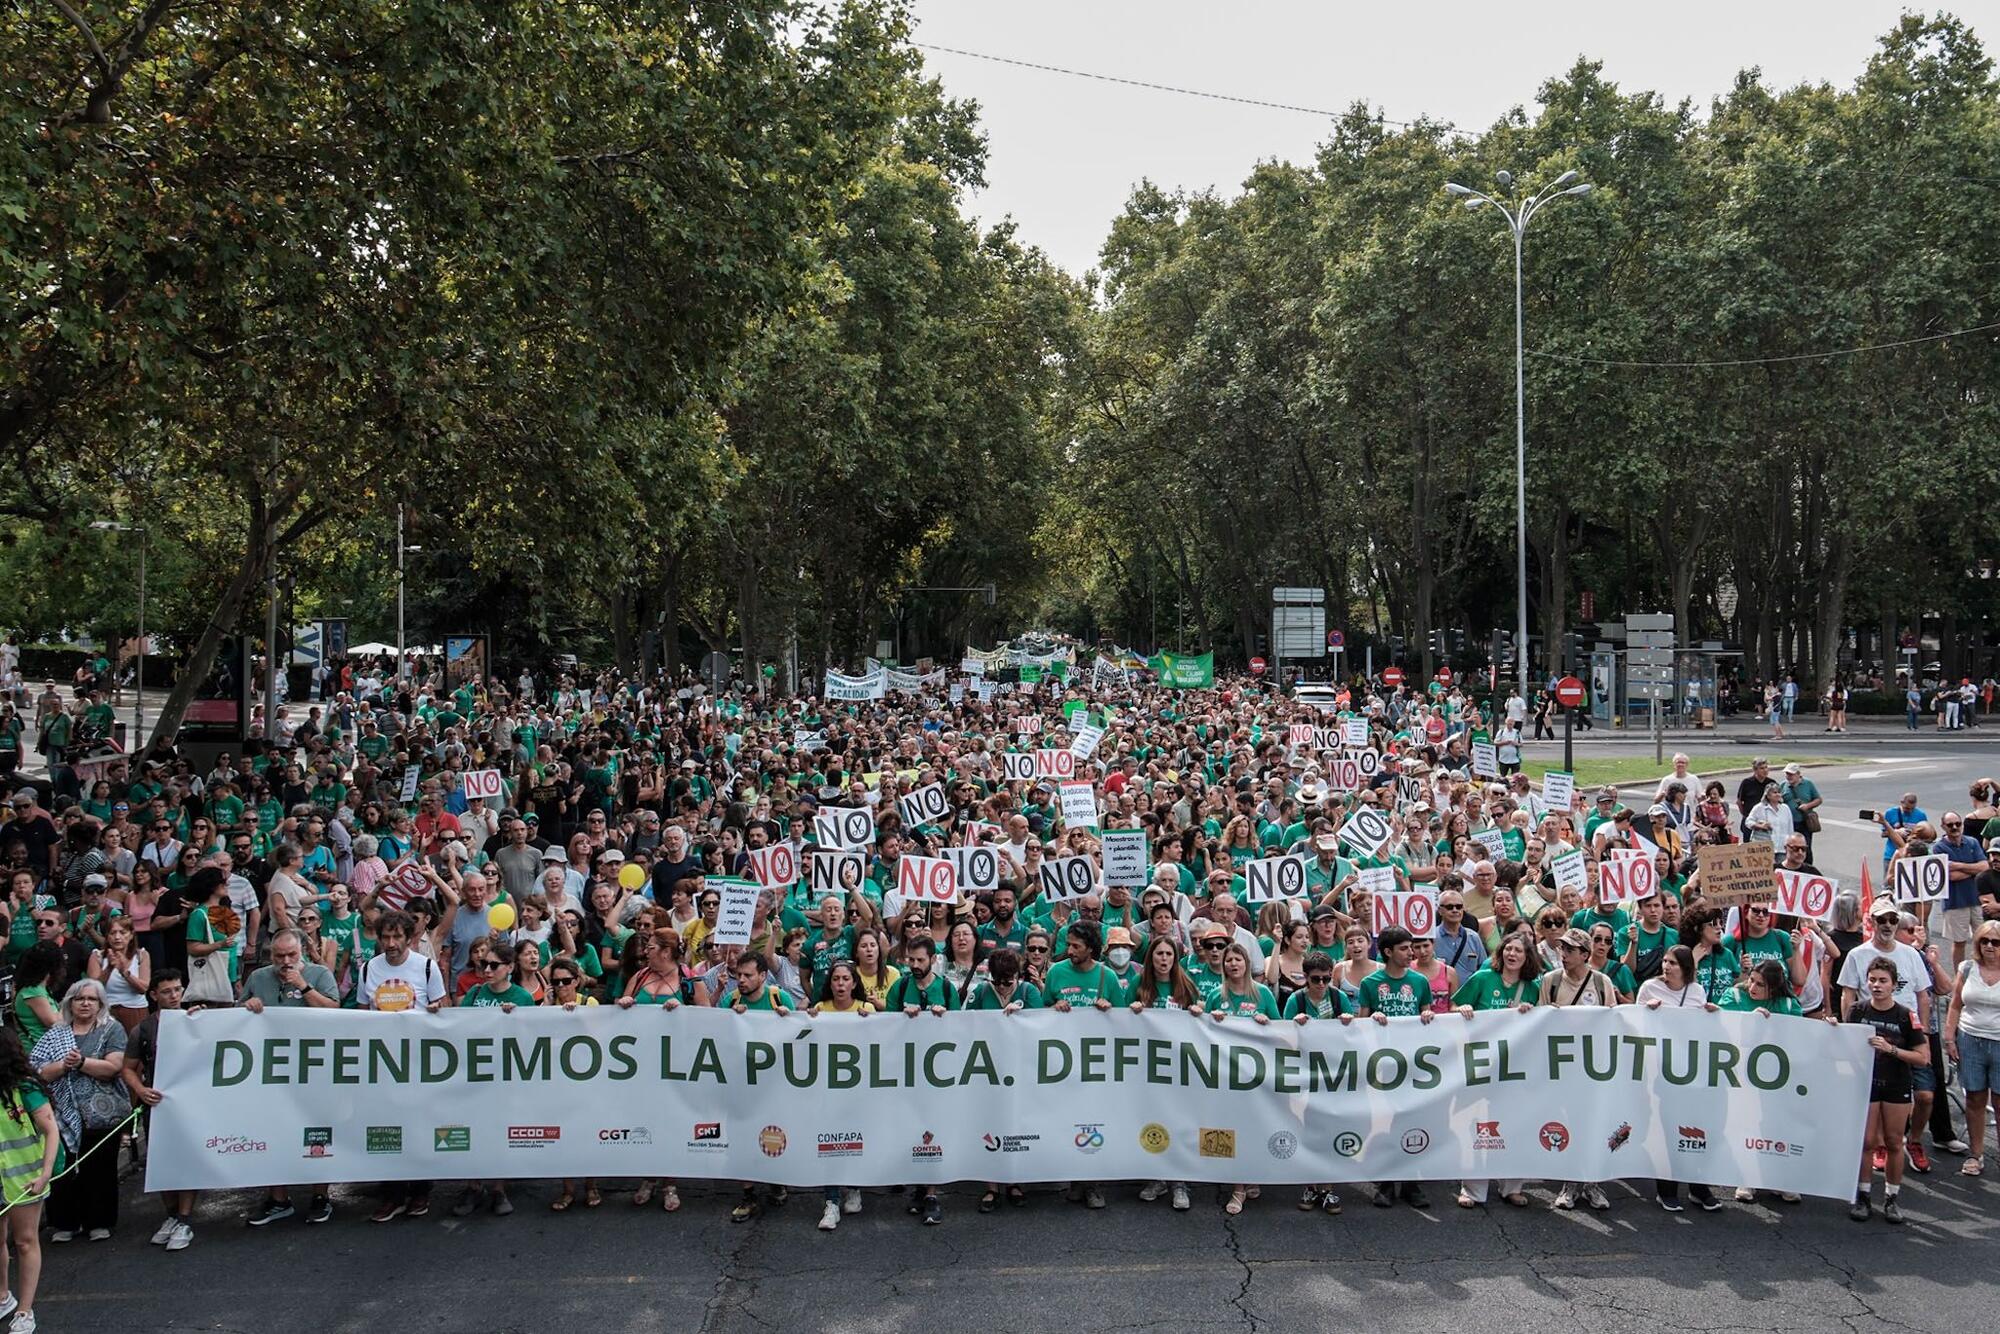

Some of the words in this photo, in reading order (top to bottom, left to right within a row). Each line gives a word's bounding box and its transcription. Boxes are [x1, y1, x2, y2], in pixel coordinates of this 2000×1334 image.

[1067, 667, 1080, 676] NO
[1000, 682, 1014, 692] NO
[924, 699, 939, 709] NO
[1019, 717, 1040, 732] NO
[1291, 725, 1312, 742] NO
[1412, 727, 1425, 744] NO
[1314, 730, 1340, 748] NO
[1003, 755, 1034, 778] NO
[1037, 750, 1073, 775] NO
[1330, 761, 1357, 788] NO
[465, 771, 500, 797] NO
[1401, 777, 1421, 803] NO
[905, 787, 945, 823] NO
[819, 810, 872, 847] NO
[1340, 811, 1387, 855] NO
[1113, 845, 1141, 853] plantilla,
[751, 846, 793, 886] NO
[813, 854, 863, 890] NO
[900, 858, 955, 899] NO
[1041, 858, 1092, 899] NO
[1248, 857, 1303, 900] NO
[1602, 858, 1651, 900] NO
[1897, 858, 1945, 899] NO
[378, 863, 433, 911] NO
[1771, 871, 1832, 917] NO
[1375, 894, 1433, 936] NO
[212, 1035, 638, 1087] DEFENDEMOS
[660, 1036, 727, 1085] LA
[745, 1029, 1015, 1089] PÚBLICA.
[1037, 1037, 1442, 1093] DEFENDEMOS
[1464, 1039, 1525, 1087] EL
[1547, 1035, 1808, 1096] FUTURO.
[510, 1129, 544, 1137] CCOO
[599, 1129, 630, 1140] CGT
[697, 1127, 718, 1135] CNT
[818, 1132, 863, 1143] CONFAPA
[1678, 1139, 1706, 1149] STEM
[1745, 1138, 1773, 1151] UGT
